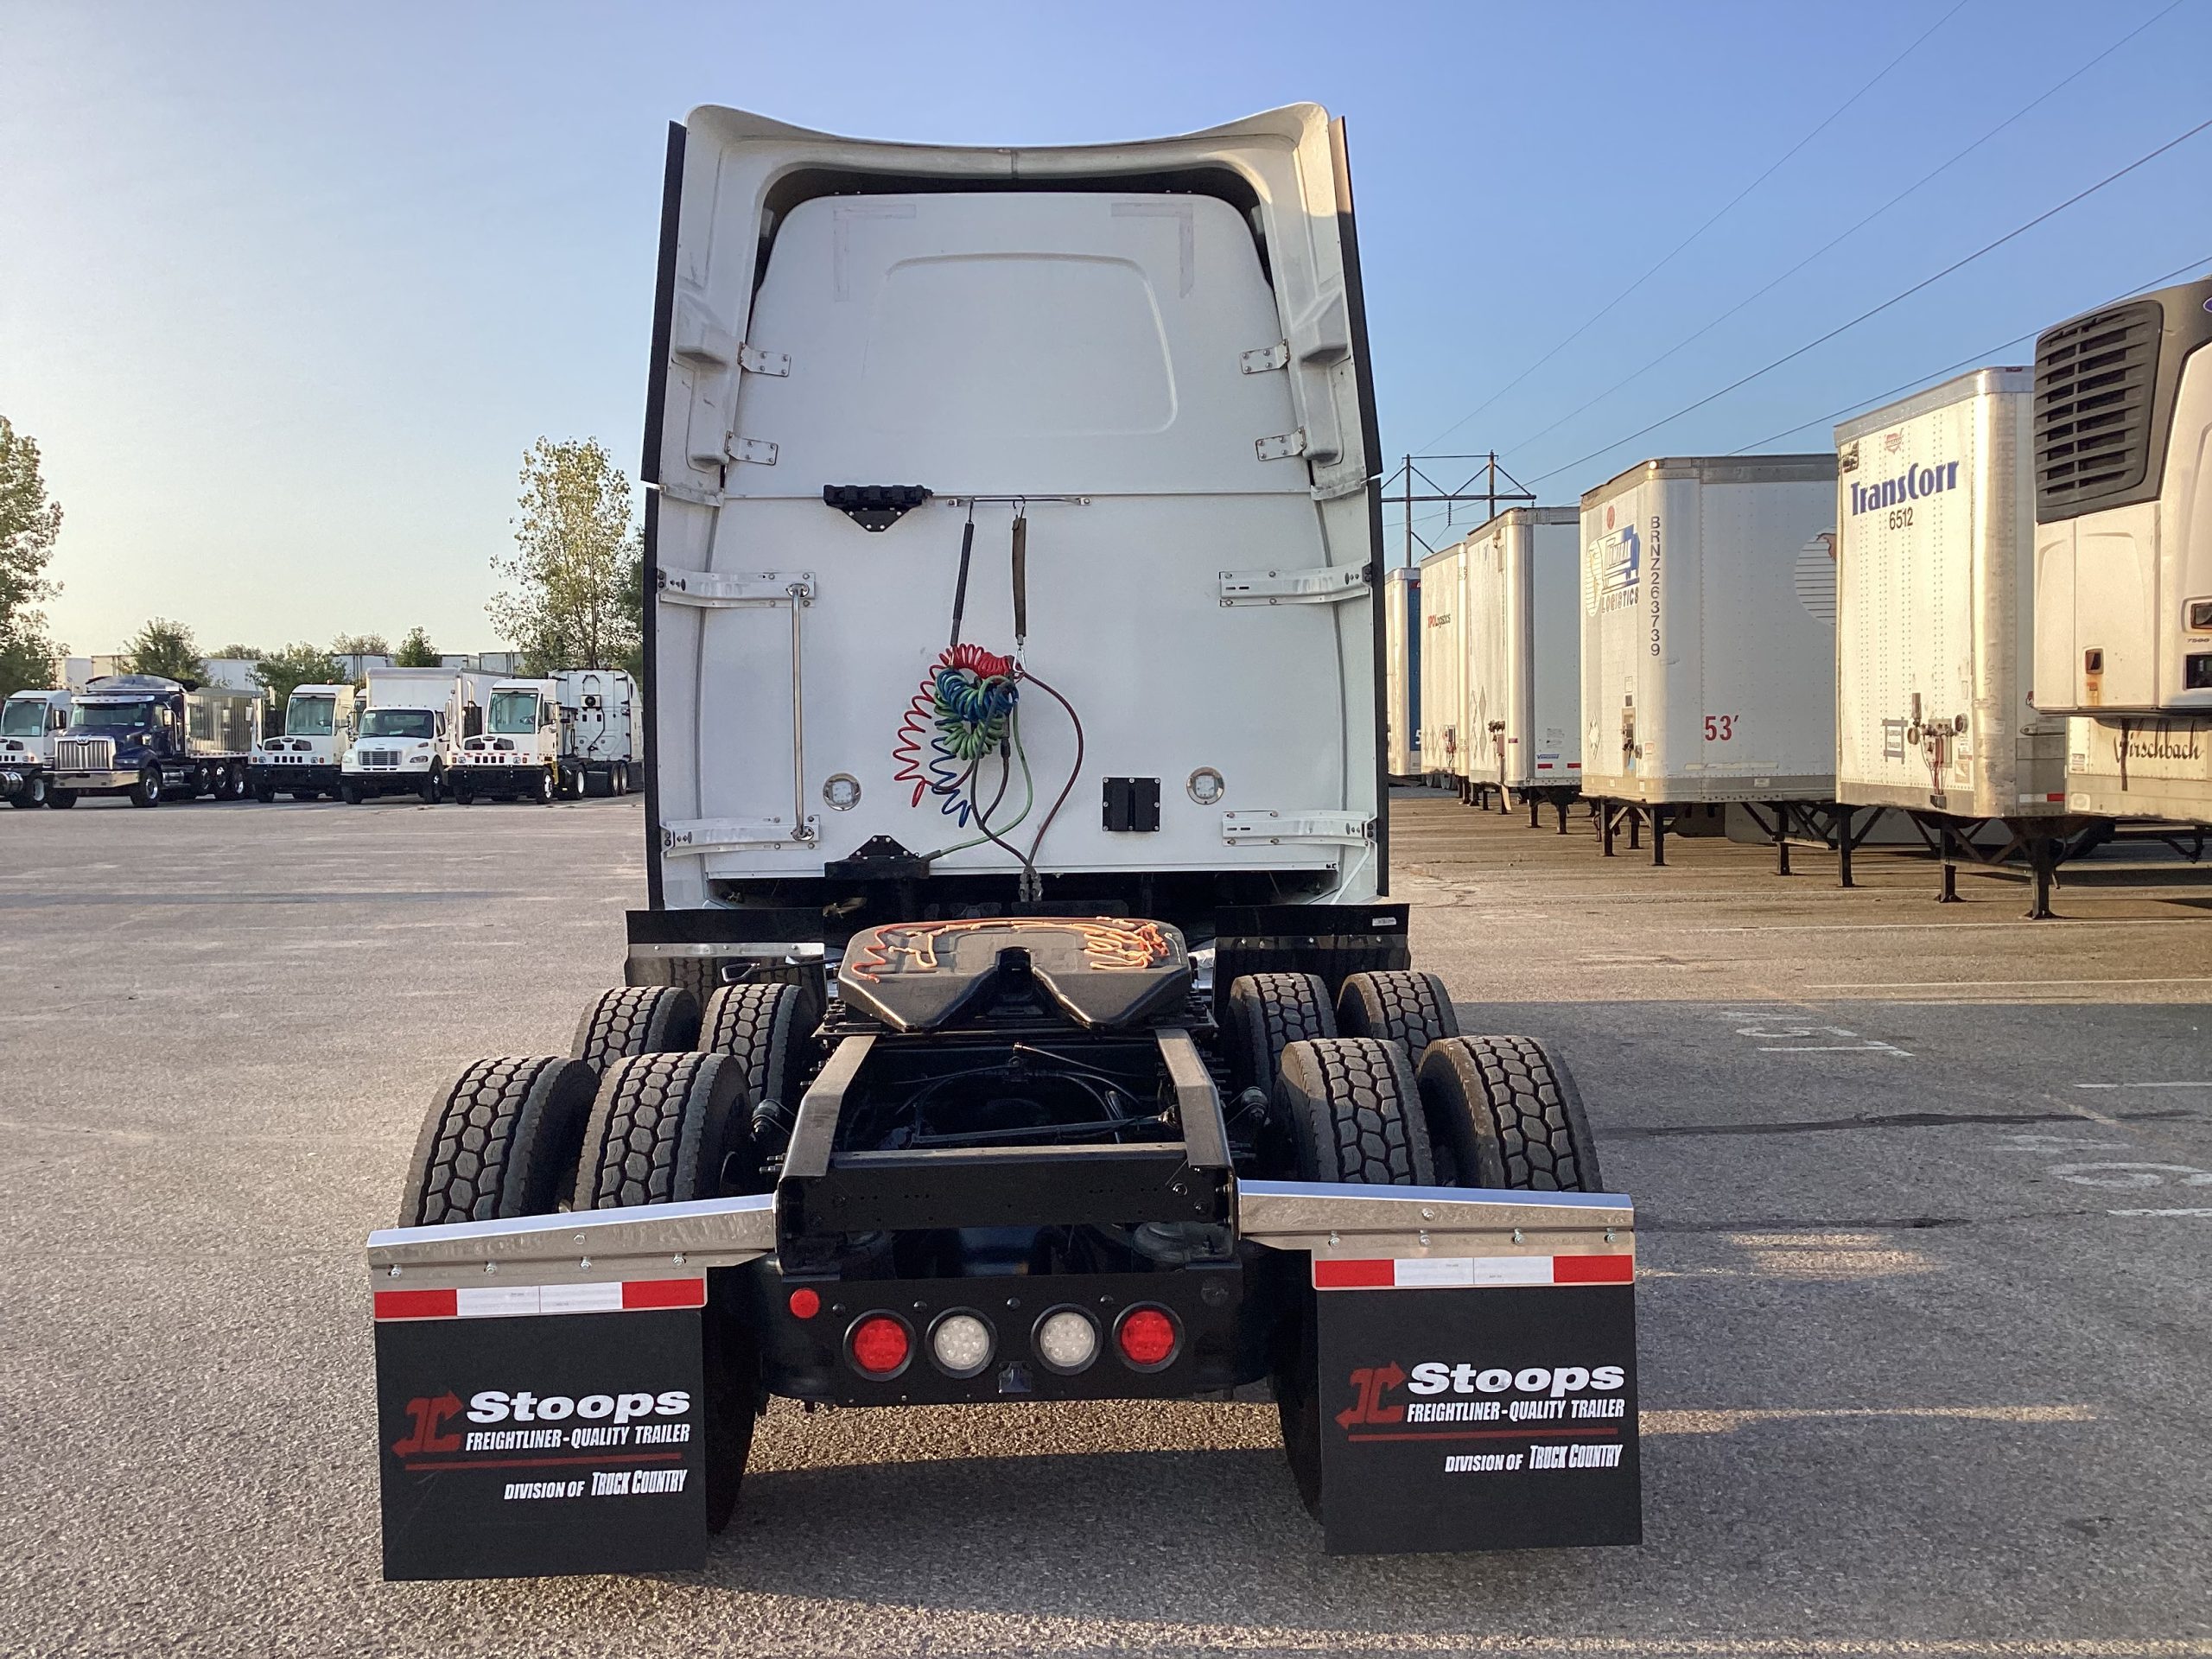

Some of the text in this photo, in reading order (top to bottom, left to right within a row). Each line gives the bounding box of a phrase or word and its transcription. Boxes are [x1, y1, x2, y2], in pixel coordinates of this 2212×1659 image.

[1850, 460, 1960, 517] TransCorr
[1889, 506, 1914, 531] 6512
[1601, 587, 1639, 613] LOGISTICS
[1650, 516, 1661, 657] BRNZ263739
[1408, 1362, 1625, 1398] Stoops
[466, 1390, 690, 1424] Stoops
[1571, 1399, 1625, 1419] TRAILER
[634, 1424, 690, 1444] TRAILER
[1445, 1444, 1624, 1472] DIVISION OF TRUCK COUNTRY
[504, 1469, 688, 1501] DIVISION OF TRUCK COUNTRY
